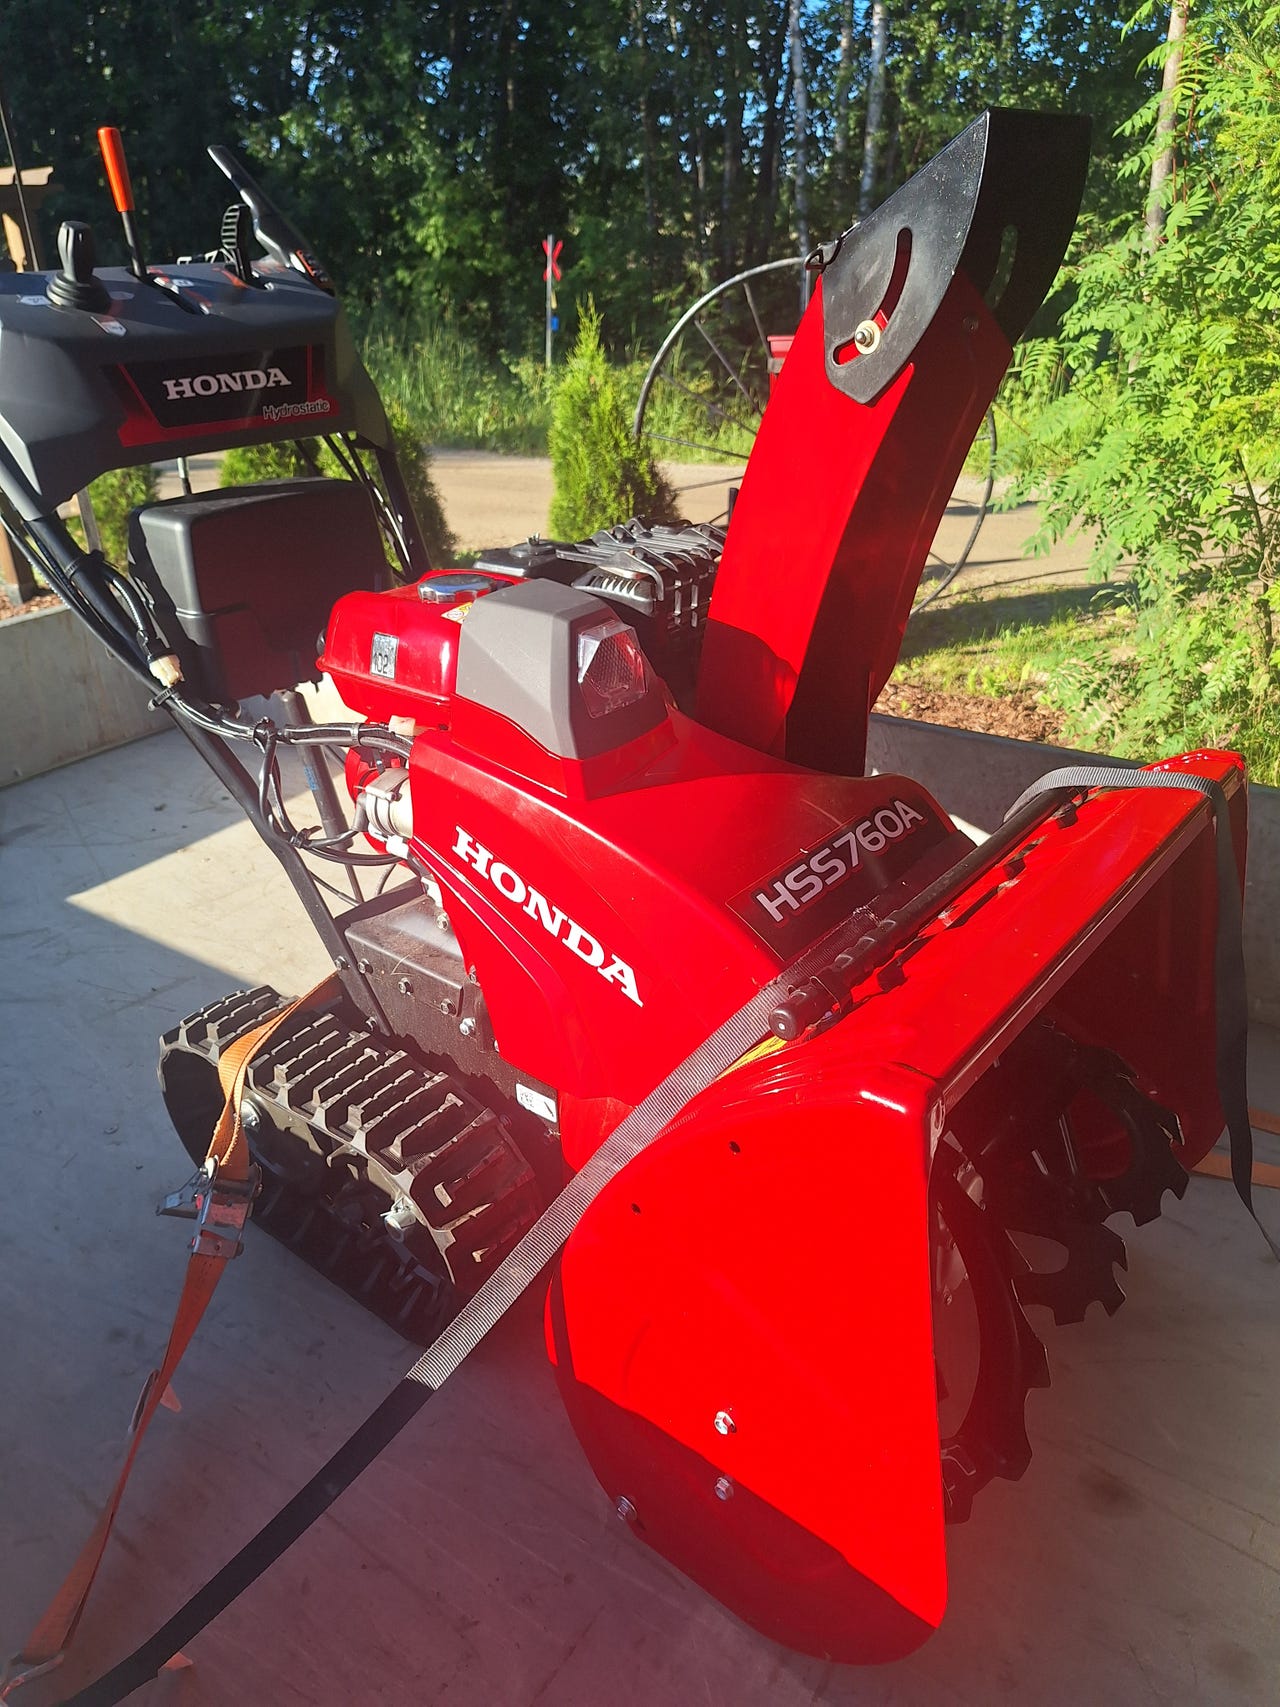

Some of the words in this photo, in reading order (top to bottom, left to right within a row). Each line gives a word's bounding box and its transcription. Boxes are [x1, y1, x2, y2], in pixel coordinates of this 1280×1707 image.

[162, 368, 291, 400] HONDA
[263, 399, 330, 421] Hydrostatic
[756, 800, 924, 922] HSS760A
[452, 825, 644, 1007] HONDA
